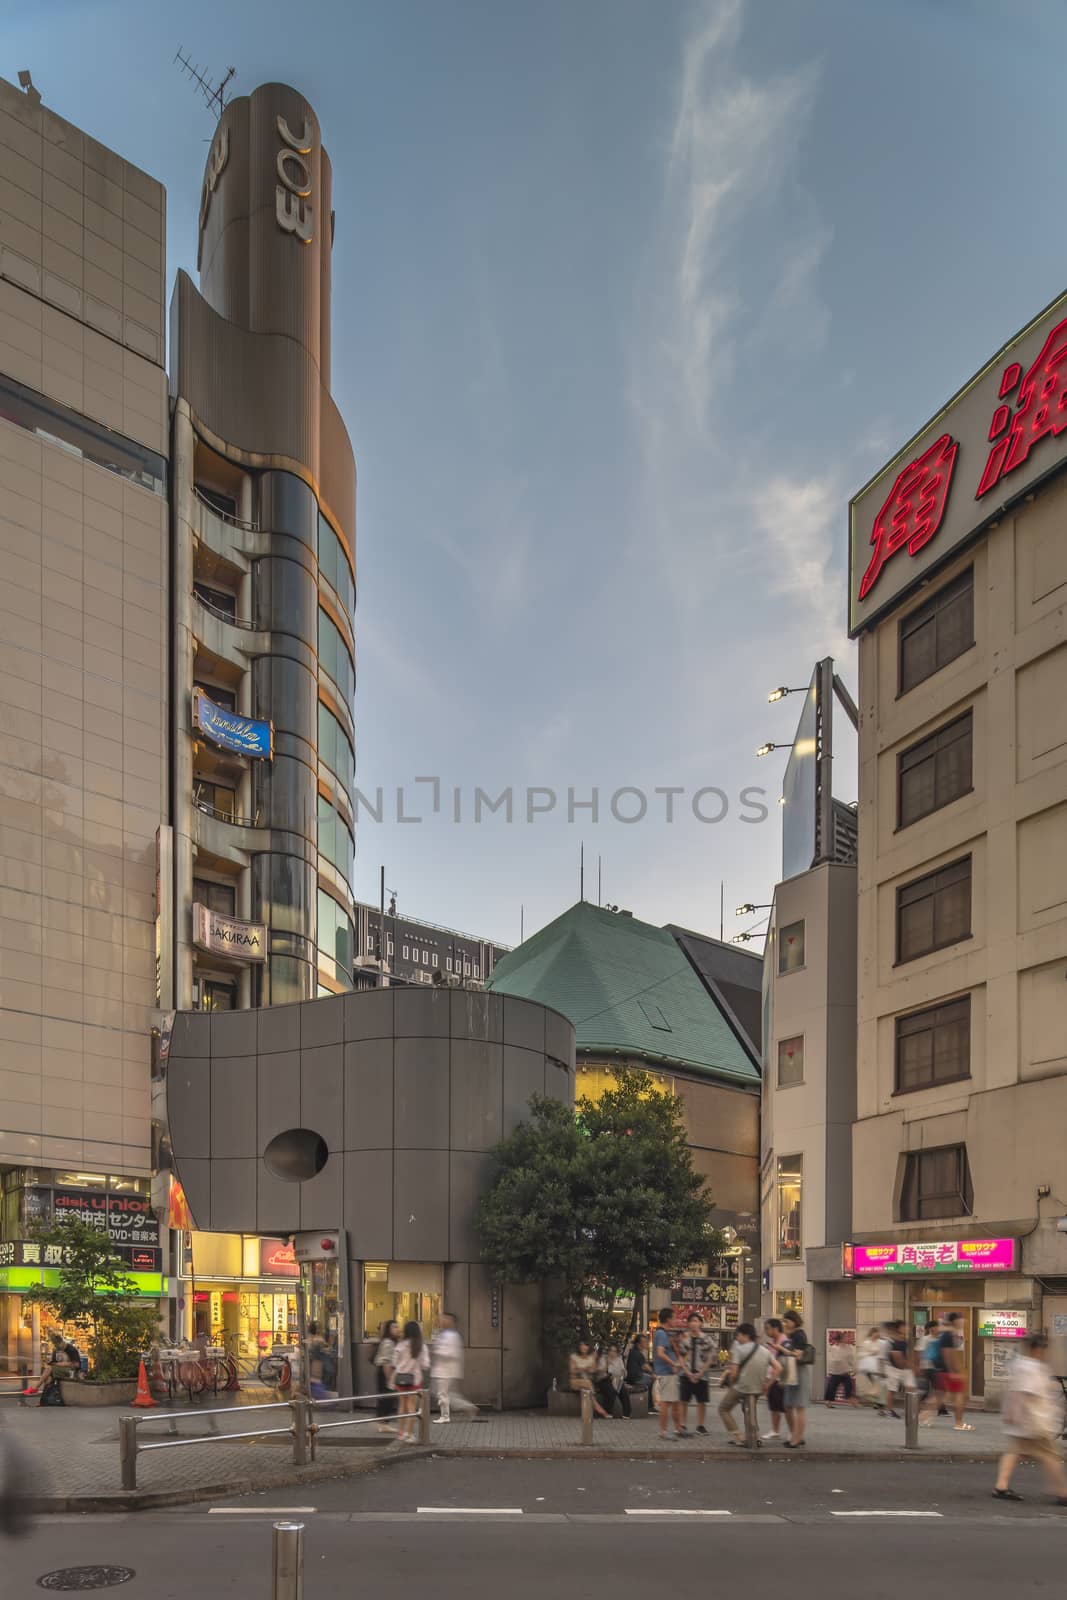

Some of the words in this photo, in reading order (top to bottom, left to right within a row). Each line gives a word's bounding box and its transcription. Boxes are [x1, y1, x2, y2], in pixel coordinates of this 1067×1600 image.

[55, 1196, 89, 1208] disk
[902, 1244, 954, 1271] 角海老
